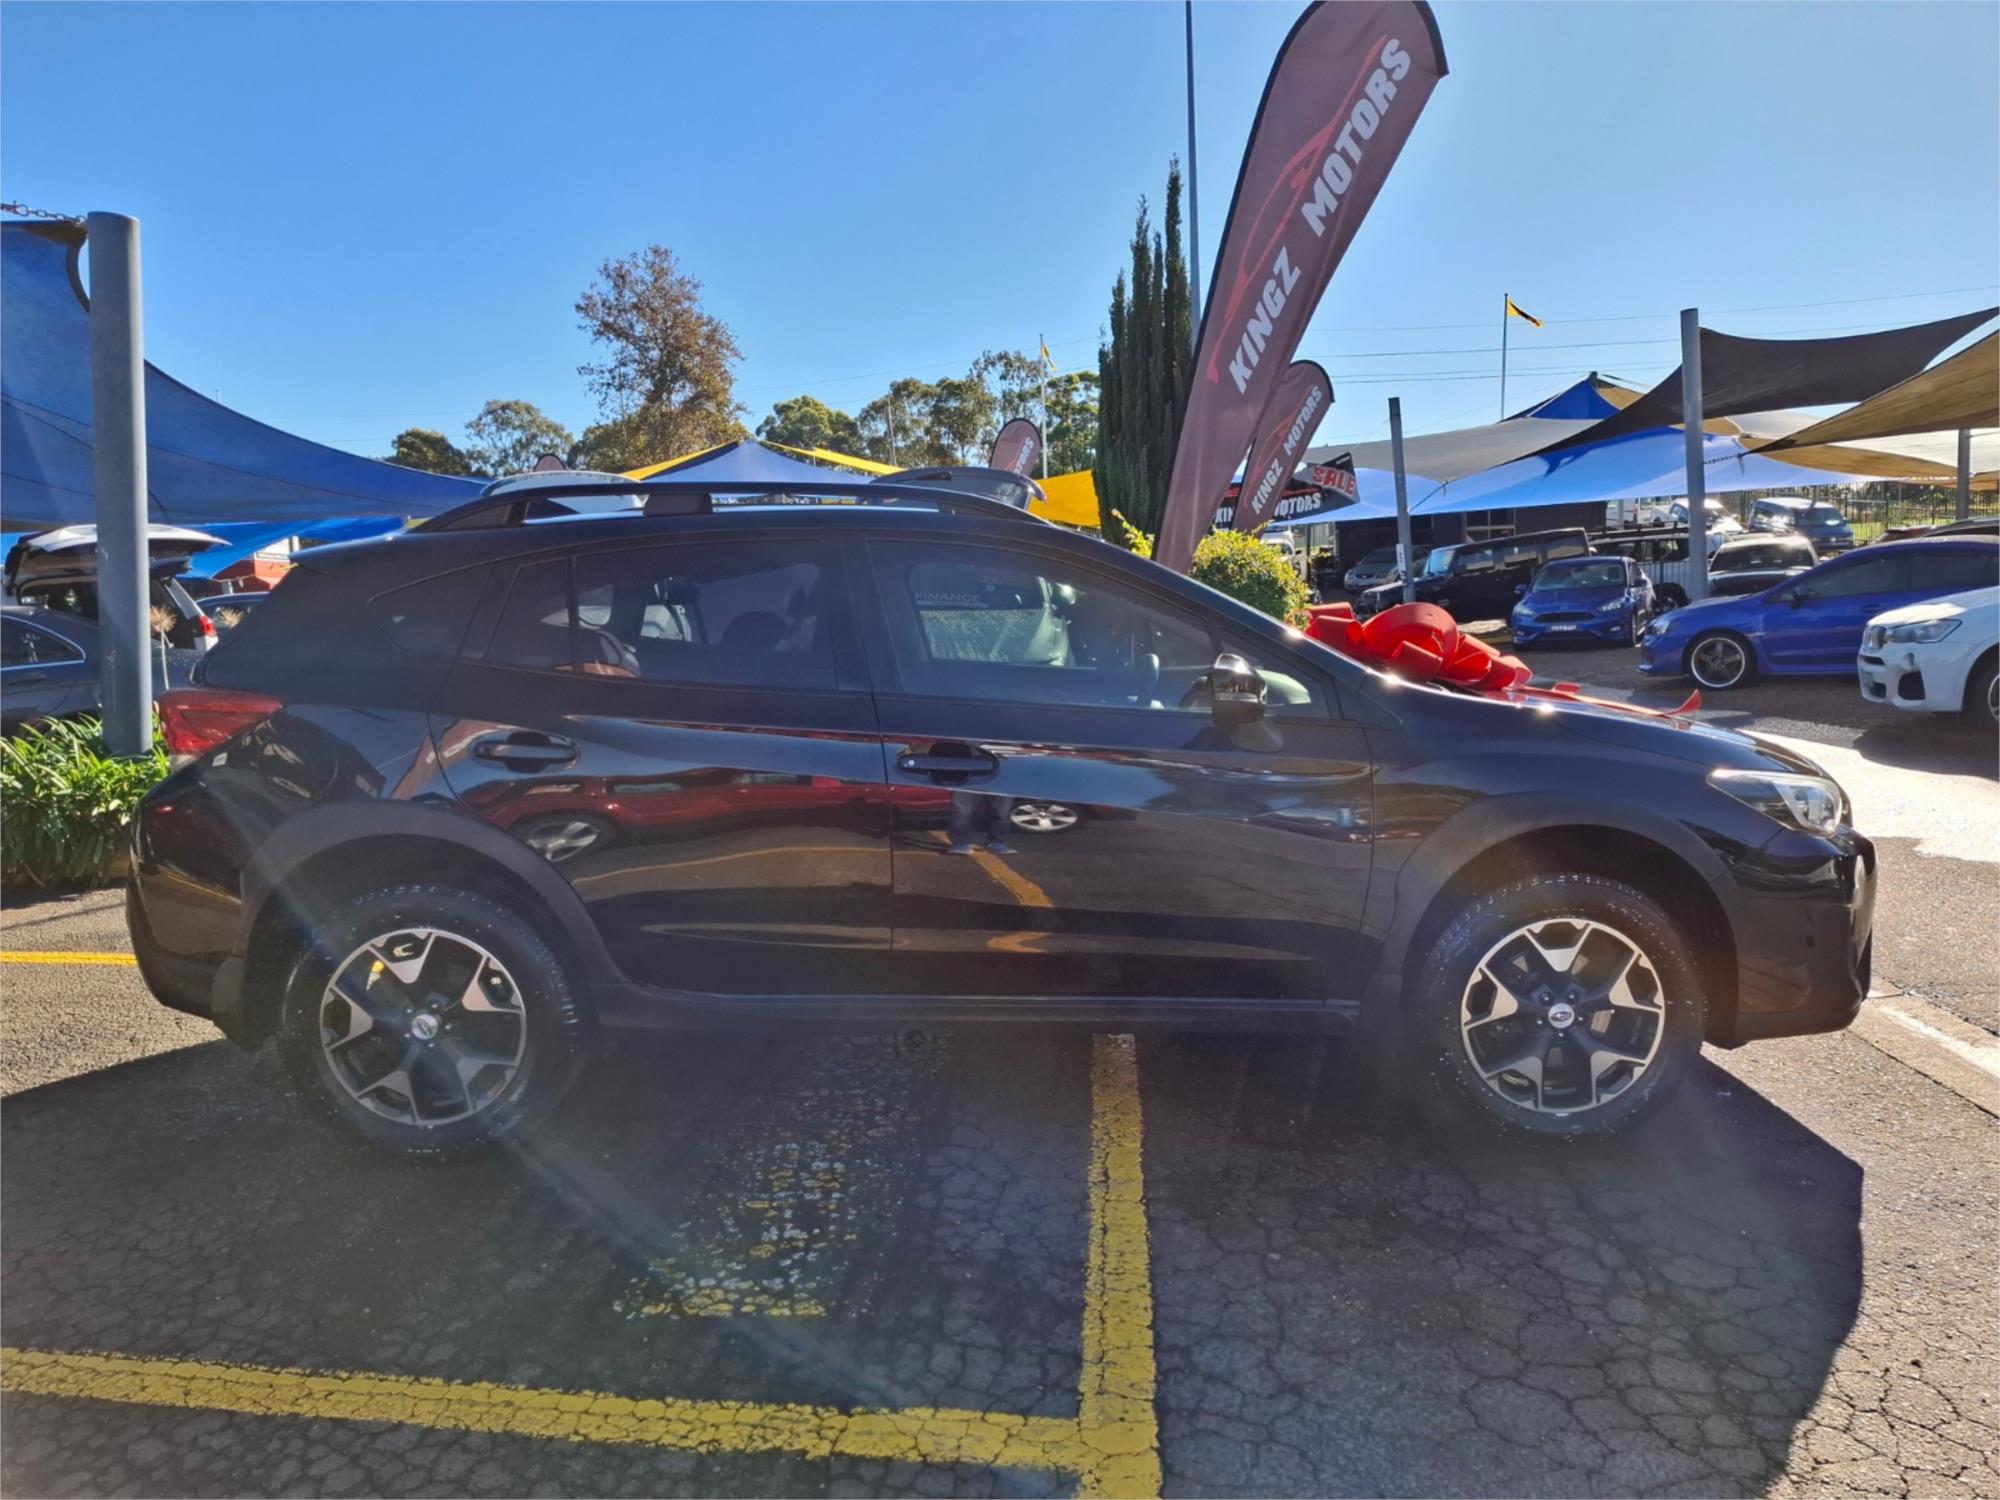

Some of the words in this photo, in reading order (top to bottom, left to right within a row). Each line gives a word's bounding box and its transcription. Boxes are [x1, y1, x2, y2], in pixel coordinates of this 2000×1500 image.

[1229, 245, 1301, 394] KINGZ
[1301, 38, 1411, 238] MOTORS
[1251, 458, 1283, 514] KINGZ
[1283, 386, 1322, 455] MOTORS
[1312, 464, 1356, 496] SALE
